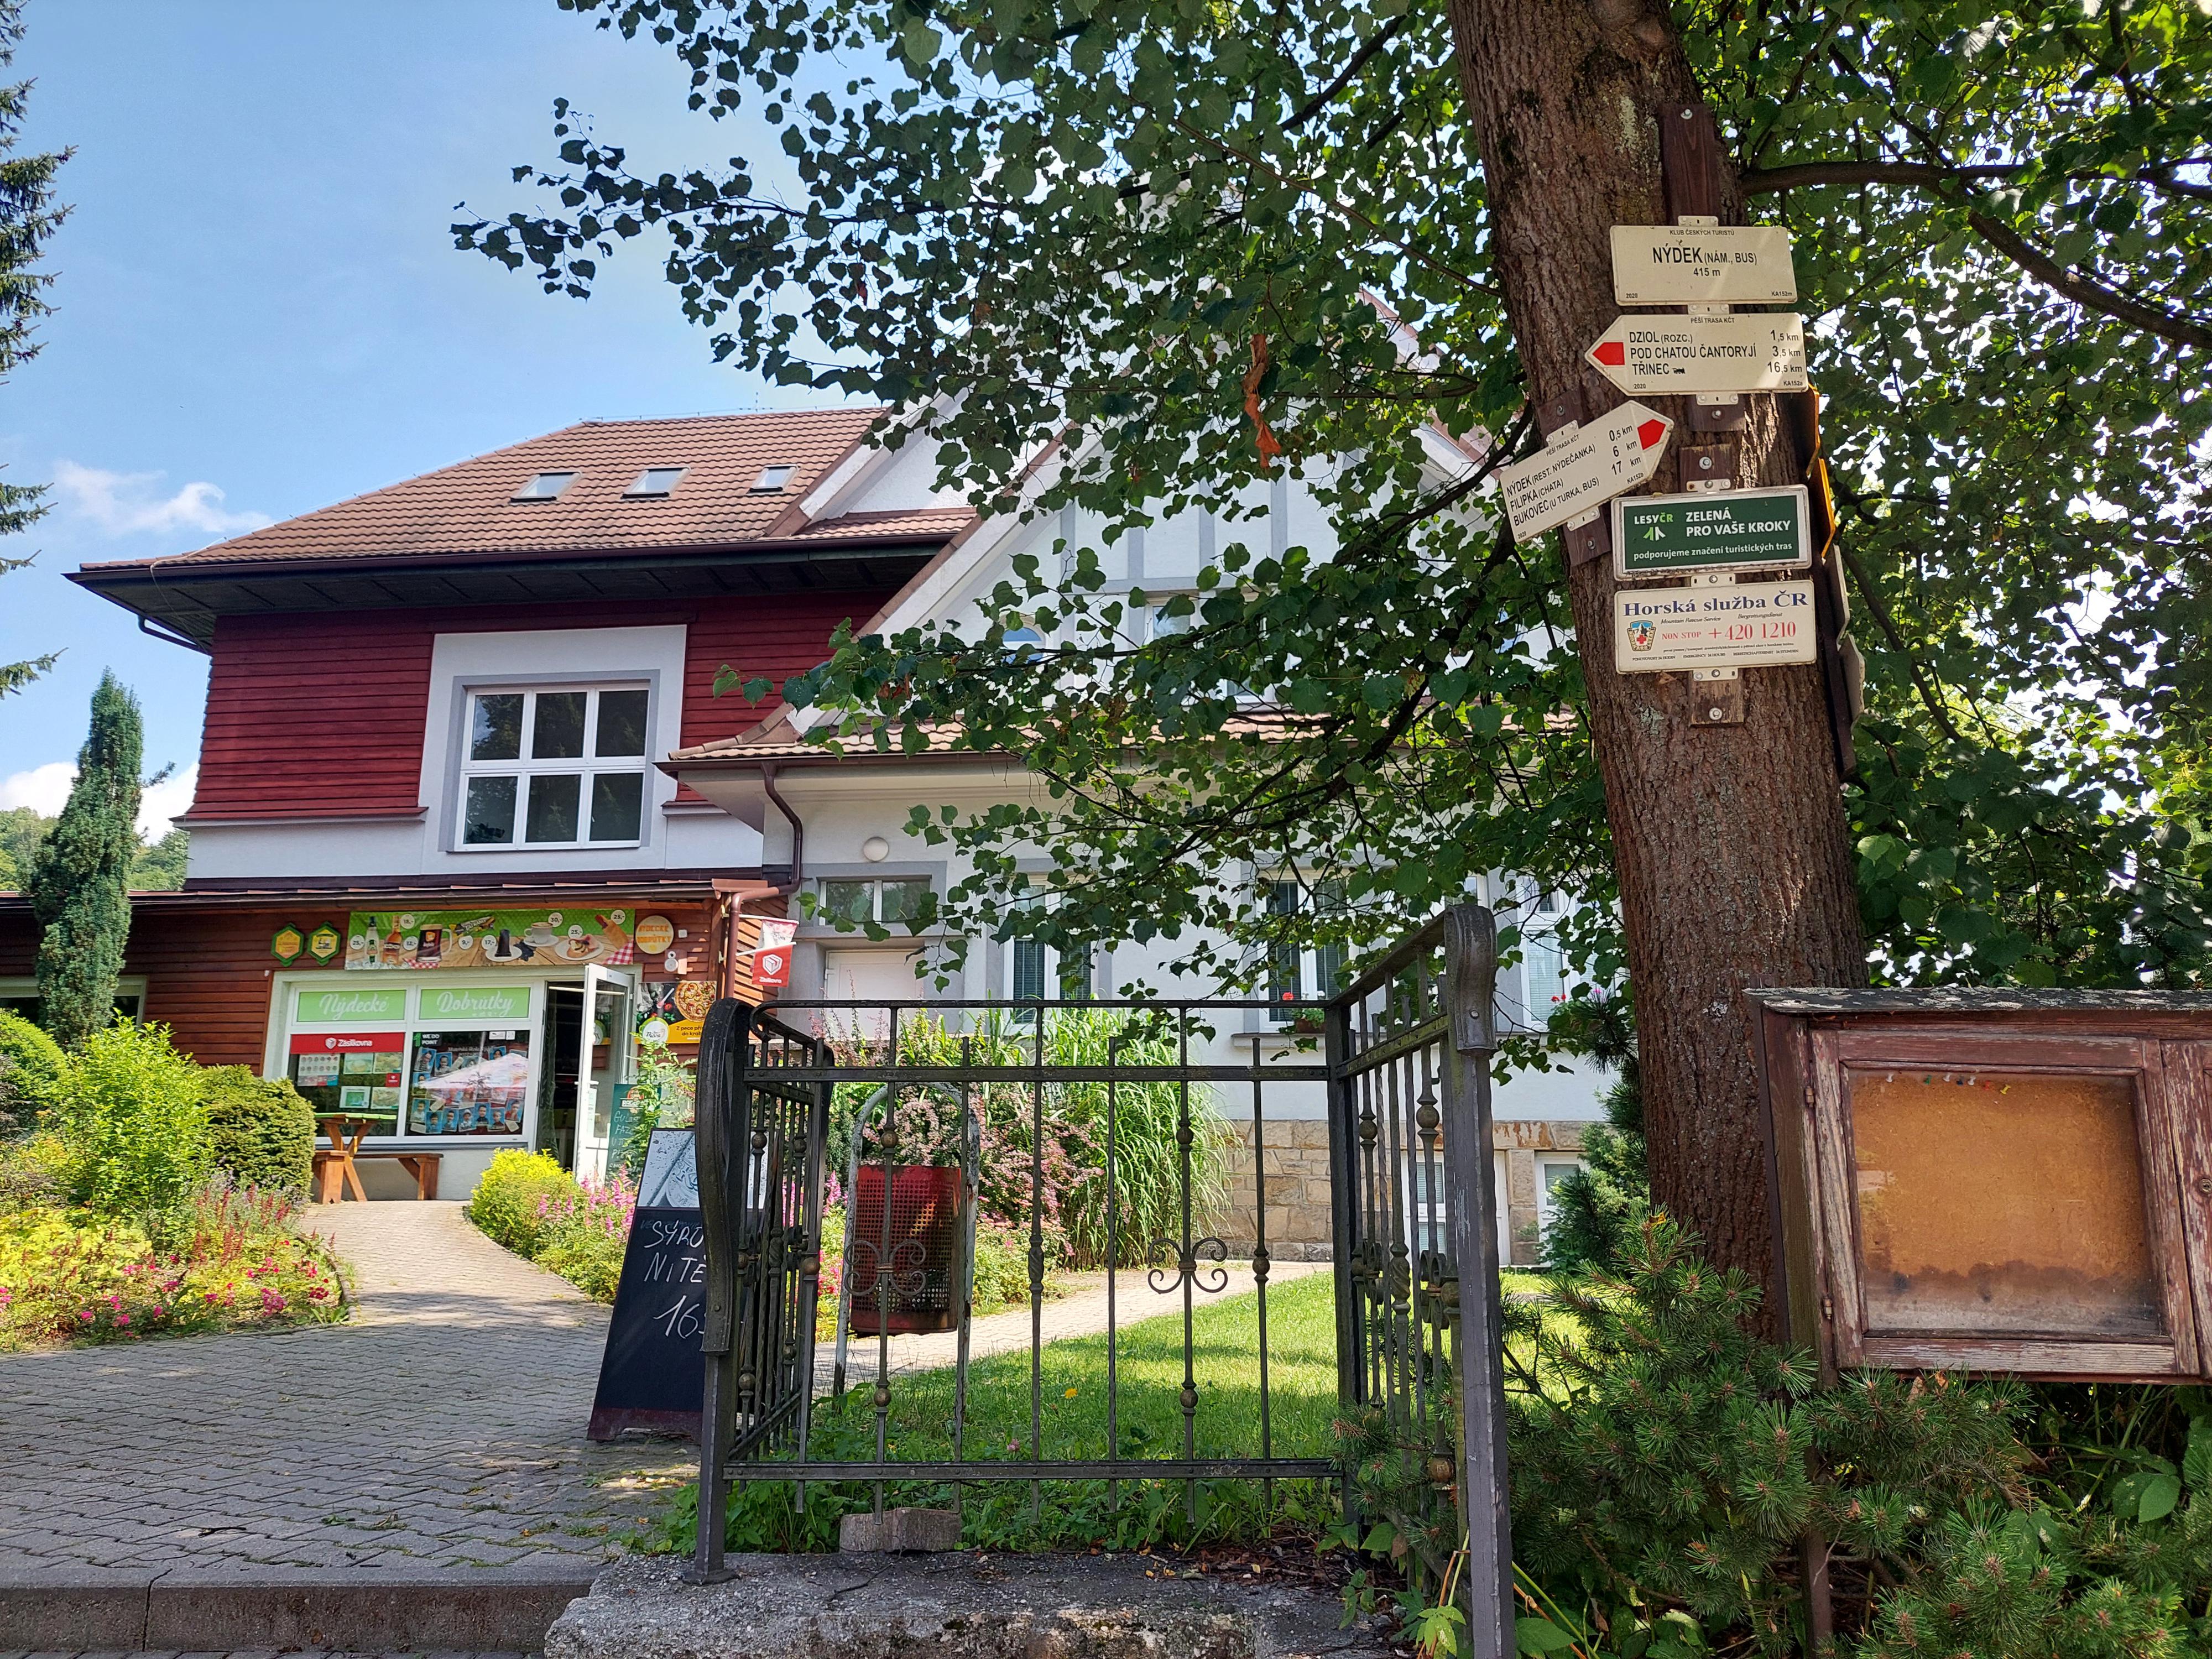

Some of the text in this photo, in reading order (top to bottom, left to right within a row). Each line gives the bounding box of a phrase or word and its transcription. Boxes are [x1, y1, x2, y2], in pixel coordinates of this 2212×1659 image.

[1652, 243, 1757, 265] NÝDEK (NÁM., BUS)
[1693, 268, 1709, 276] 415
[1629, 330, 1799, 345] DZIOL (ROZC.) 1,5 km
[1630, 347, 1652, 359] POD
[1655, 346, 1696, 359] CHATOU
[1699, 342, 1756, 358] ČANTORYJÍ
[1772, 345, 1786, 358] 3,5
[1632, 361, 1803, 375] TŘINEC 16,5 km
[1546, 434, 1580, 457] PĚŠÍ TRASA KČT
[1506, 424, 1633, 498] NÝDEK (REST. NÝDEČANKA) 0,5 km
[1510, 440, 1637, 512] FILIPKA (CHATA) 6 km
[1627, 472, 1645, 484] KA152b
[1513, 456, 1641, 527] BUKOVEC (U TURKA, BUS) 17 km
[1685, 507, 1732, 523] ZELENÁ
[1517, 531, 1527, 539] 2020
[1686, 520, 1791, 538] PRO VAŠE KROKY
[1633, 541, 1792, 562] podporujeme značení turistických tras
[1623, 589, 1809, 617] Horská služba ČR
[1661, 617, 1684, 625] Mountain
[1661, 632, 1678, 640] NON
[1681, 630, 1702, 639] STOP
[1708, 624, 1754, 641] +420
[1760, 620, 1797, 639] 1210
[319, 993, 390, 1021] Nýdecké
